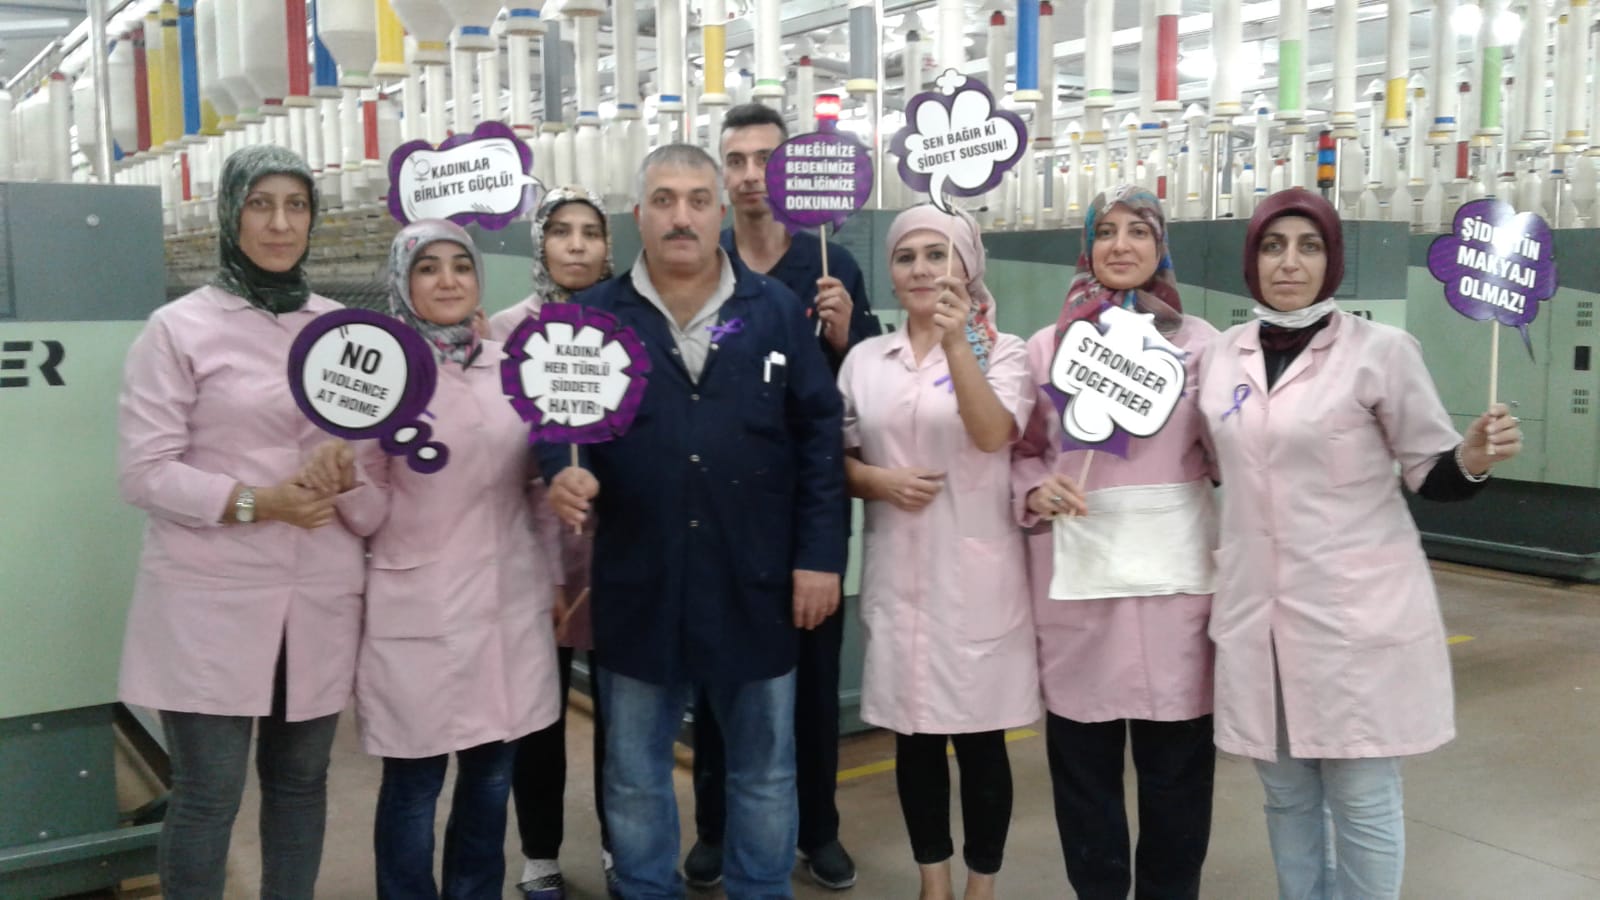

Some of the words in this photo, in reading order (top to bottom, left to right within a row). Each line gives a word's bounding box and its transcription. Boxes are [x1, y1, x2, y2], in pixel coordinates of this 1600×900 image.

[785, 141, 856, 157] EMEĞİMİZE
[922, 135, 944, 150] SEN
[946, 126, 982, 145] BAĞIR
[984, 120, 997, 136] Kİ
[431, 157, 491, 179] KADINLAR
[785, 159, 856, 174] BEDENİMİZE
[917, 150, 956, 170] ŞİDDET
[959, 138, 1008, 160] SUSSUN!
[413, 179, 465, 203] BİRLİKTE
[468, 170, 514, 193] GÜÇLÜ!
[785, 176, 855, 191] KİMLİĞİMİZE
[785, 195, 854, 210] DOKUNMA!
[1461, 216, 1541, 261] ŞİDTİN
[1456, 245, 1536, 288] MAKYAJI
[1459, 275, 1526, 314] OLMAZ!
[339, 341, 383, 375] NO
[556, 344, 601, 358] KADINA
[1078, 336, 1168, 394] STRONGER
[544, 361, 568, 374] HER
[572, 360, 611, 376] TÜRLÜ
[321, 368, 390, 400] VIOLENCE
[551, 377, 601, 393] ŞİDDETE
[1065, 359, 1153, 417] TOGETHER
[316, 388, 337, 403] AT
[337, 394, 381, 418] HOME
